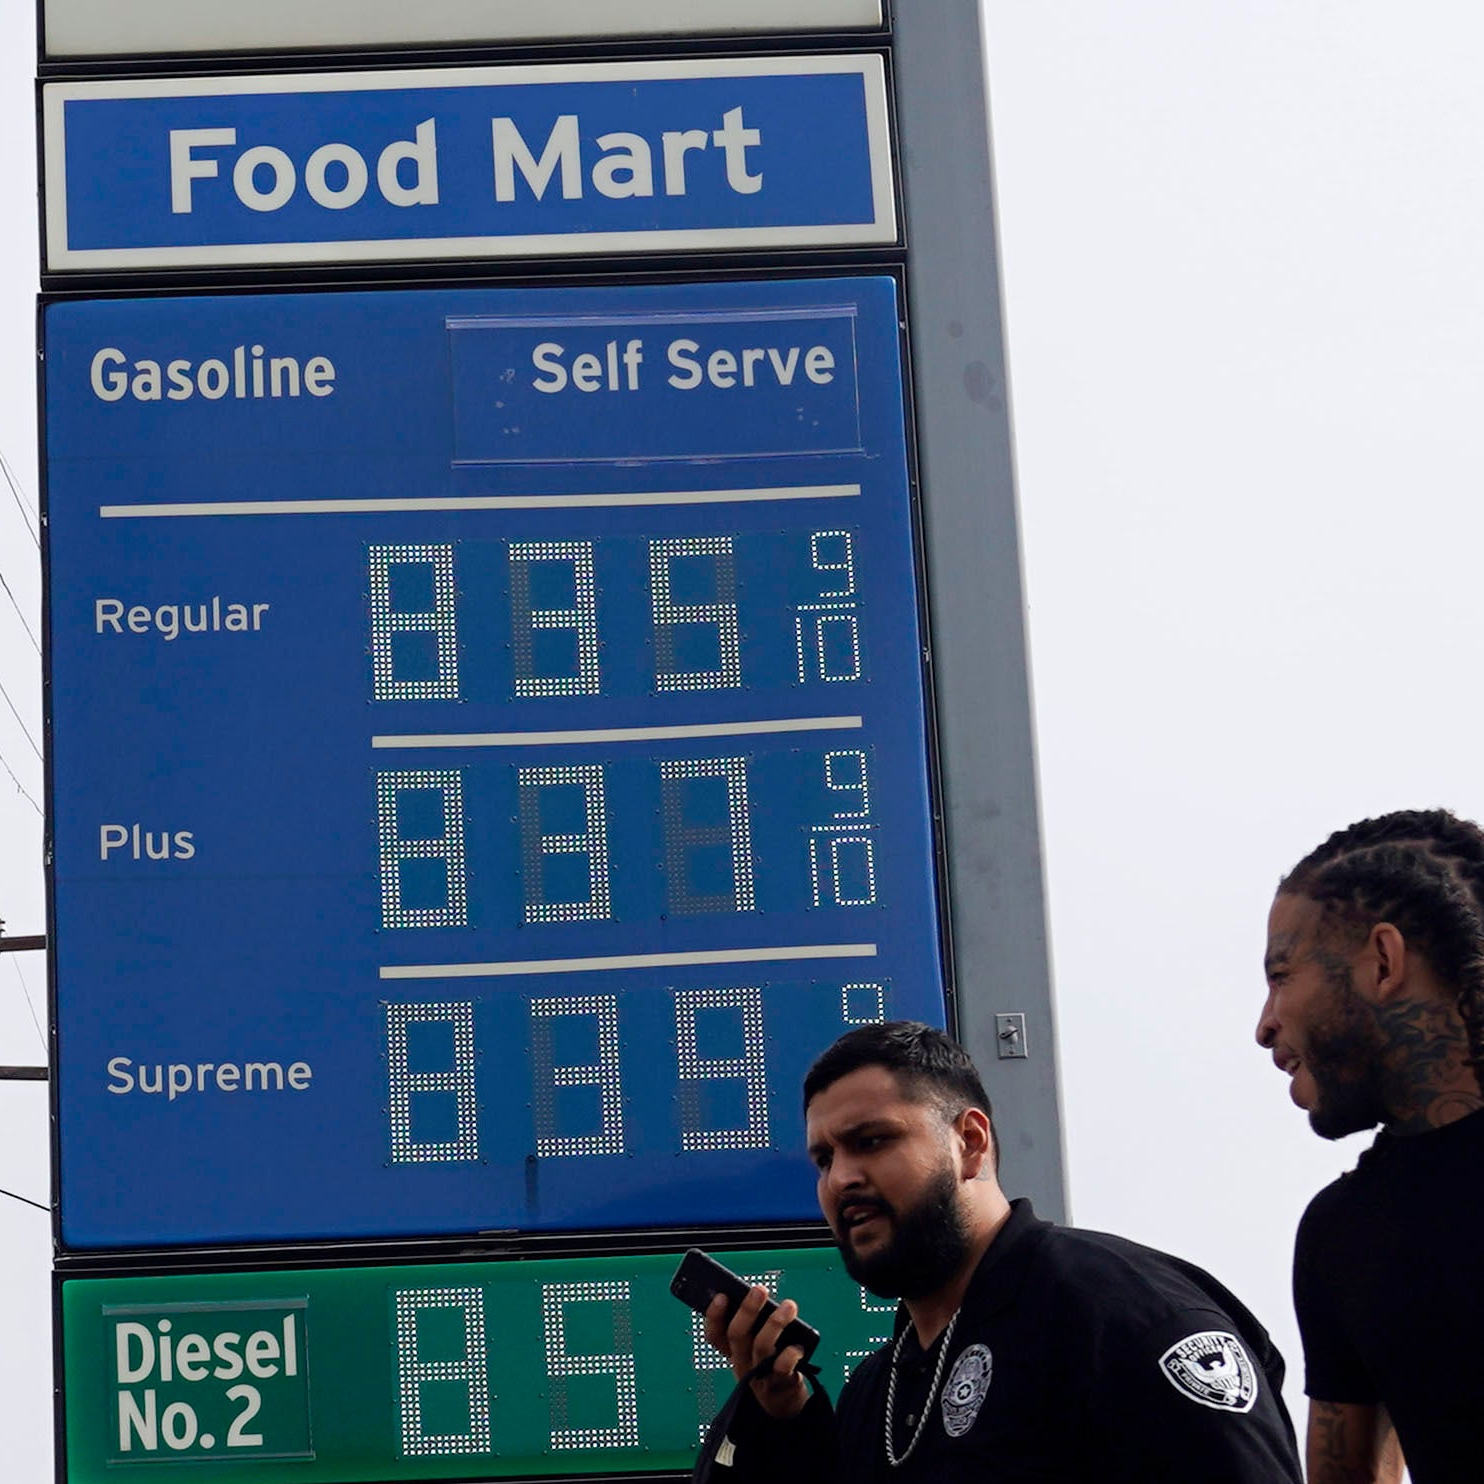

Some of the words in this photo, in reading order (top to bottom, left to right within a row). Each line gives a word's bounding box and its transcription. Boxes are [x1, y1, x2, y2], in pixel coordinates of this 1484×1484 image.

[168, 117, 440, 214] Food
[491, 106, 765, 202] Mart
[89, 344, 336, 402] Gasoline
[532, 338, 643, 394] Self
[666, 340, 836, 391] Serve
[95, 597, 270, 643] Regular
[99, 823, 196, 861] Plus
[106, 1056, 313, 1102] Supreme
[116, 1315, 299, 1384] Diesel
